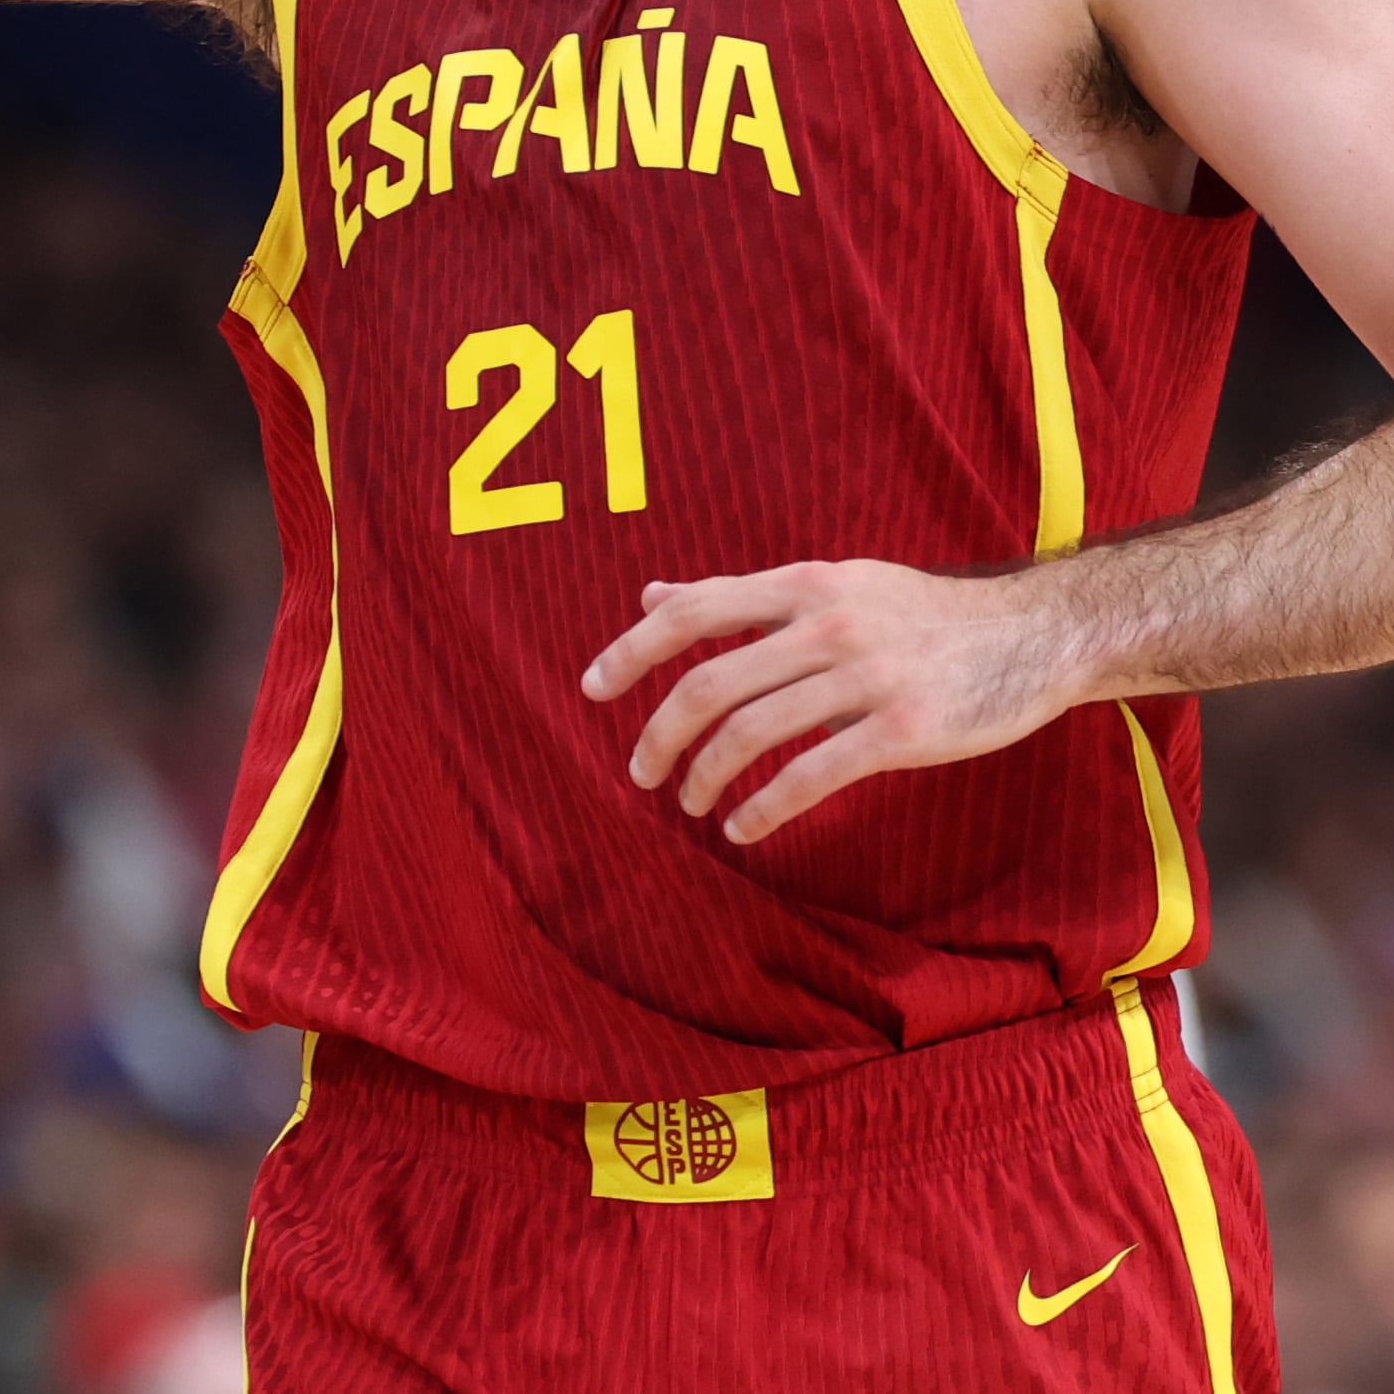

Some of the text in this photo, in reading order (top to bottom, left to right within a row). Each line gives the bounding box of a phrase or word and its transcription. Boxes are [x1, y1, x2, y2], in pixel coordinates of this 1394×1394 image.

[325, 7, 802, 269] ESPAÑA
[445, 309, 648, 536] 21
[664, 1101, 686, 1185] ESP
